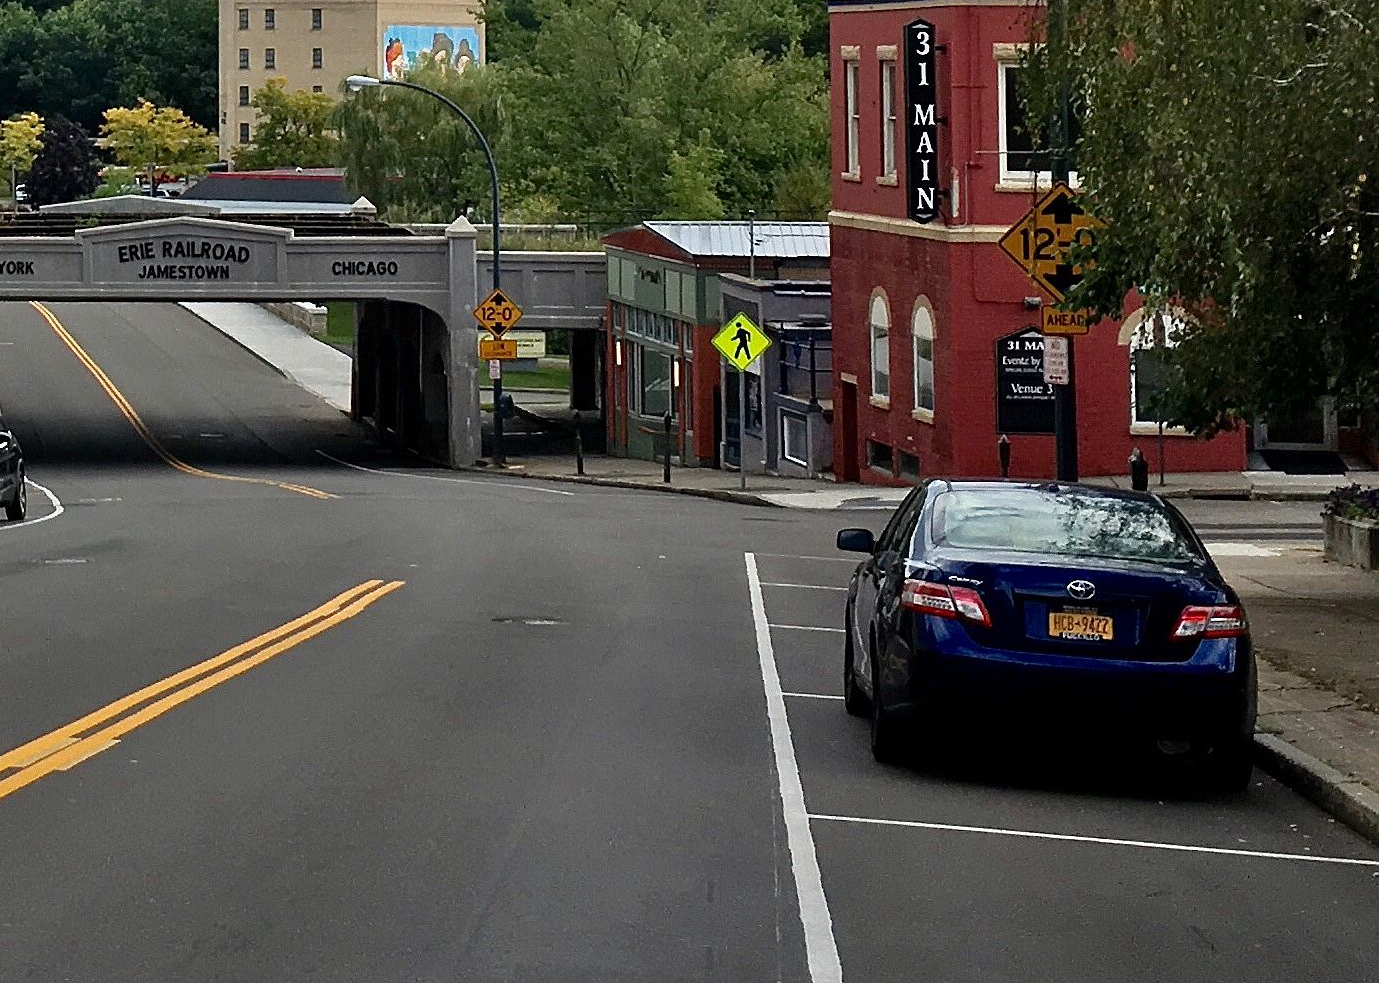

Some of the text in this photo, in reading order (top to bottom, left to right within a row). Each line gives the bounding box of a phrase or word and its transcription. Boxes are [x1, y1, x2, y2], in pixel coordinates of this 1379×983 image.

[913, 31, 936, 210] 31 MAIN
[118, 240, 250, 264] ERIE RAILROAD
[138, 265, 230, 280] JAMESTOWN
[332, 261, 398, 276] CHICAGO
[1007, 340, 1045, 351] 31 MA
[1031, 355, 1042, 370] by
[1011, 383, 1043, 394] Venue
